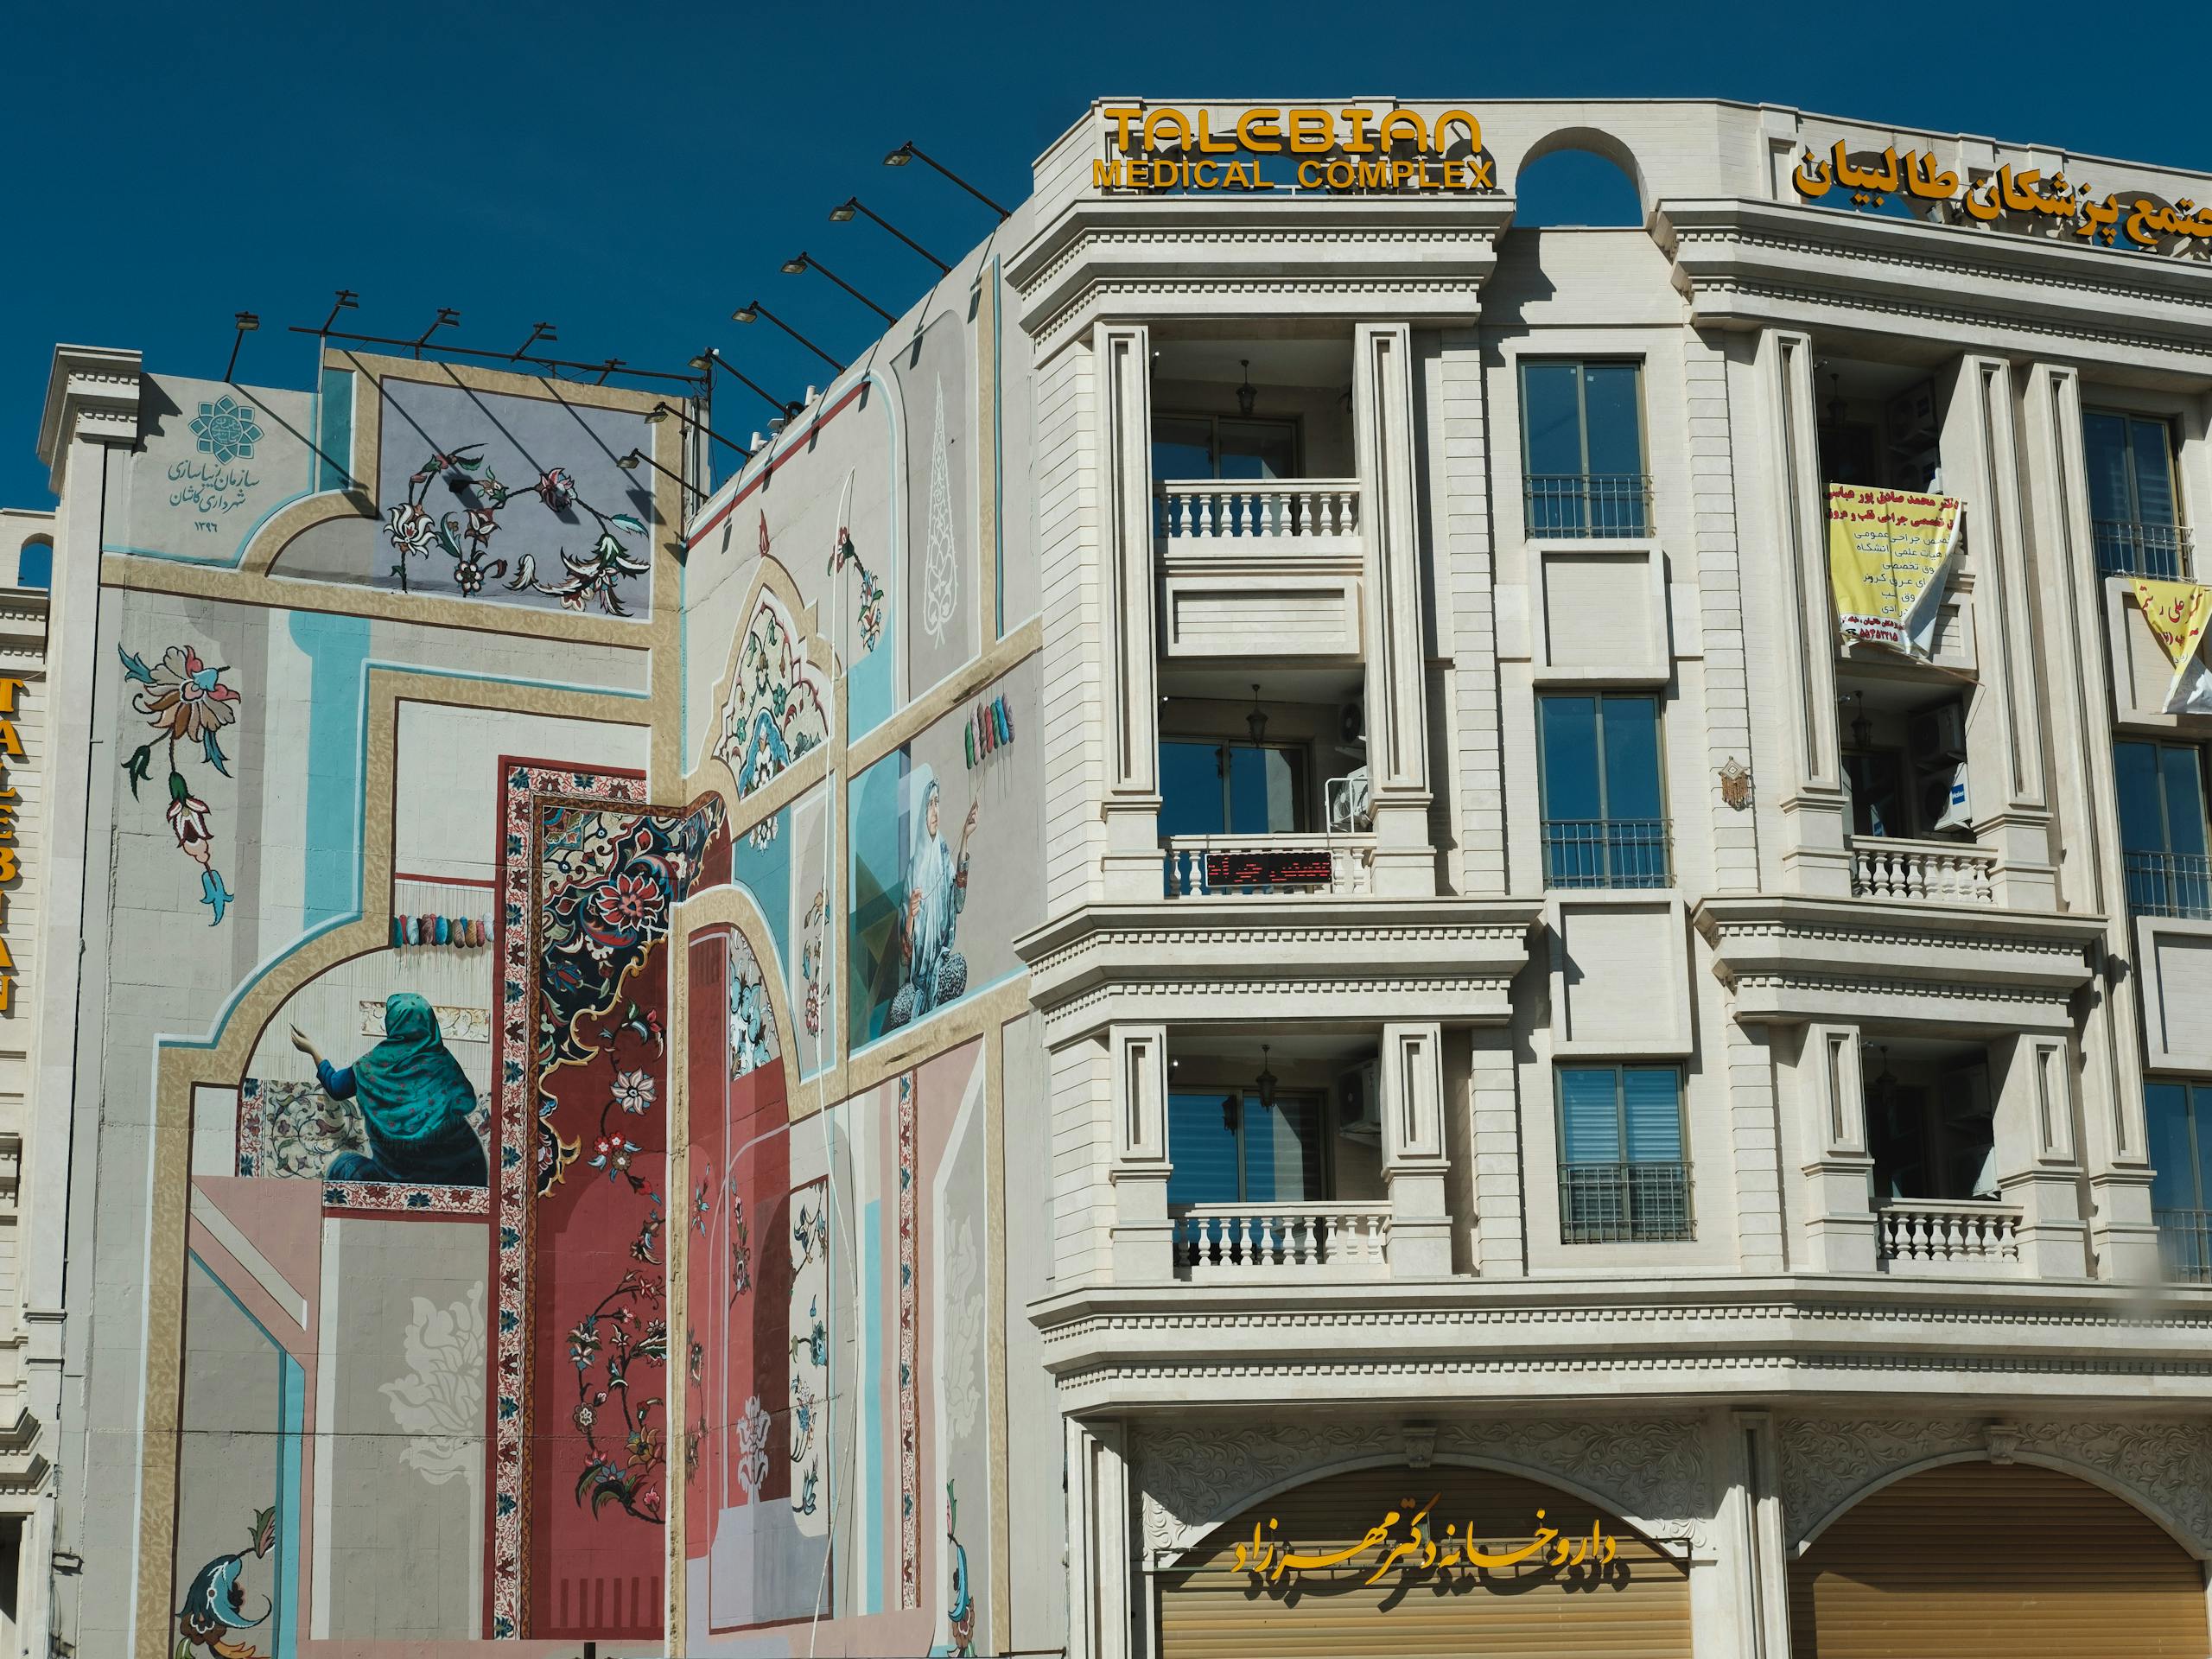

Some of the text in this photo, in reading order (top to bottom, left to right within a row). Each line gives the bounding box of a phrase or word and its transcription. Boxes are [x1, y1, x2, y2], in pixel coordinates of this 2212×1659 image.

[1103, 107, 1484, 155] TALEBIAN
[1092, 159, 1495, 190] MEDICAL COMPLEX
[1791, 138, 2212, 248] جتمع پزشکان طالبیان
[168, 460, 260, 492] سازمان زیباسازی
[169, 486, 246, 515] شهرداری کاشان
[1858, 491, 1876, 505] پور
[1876, 491, 1905, 505] صادق
[1907, 495, 1936, 507] محمد
[1856, 543, 1890, 553] انشگاه
[1922, 564, 1936, 575] وق
